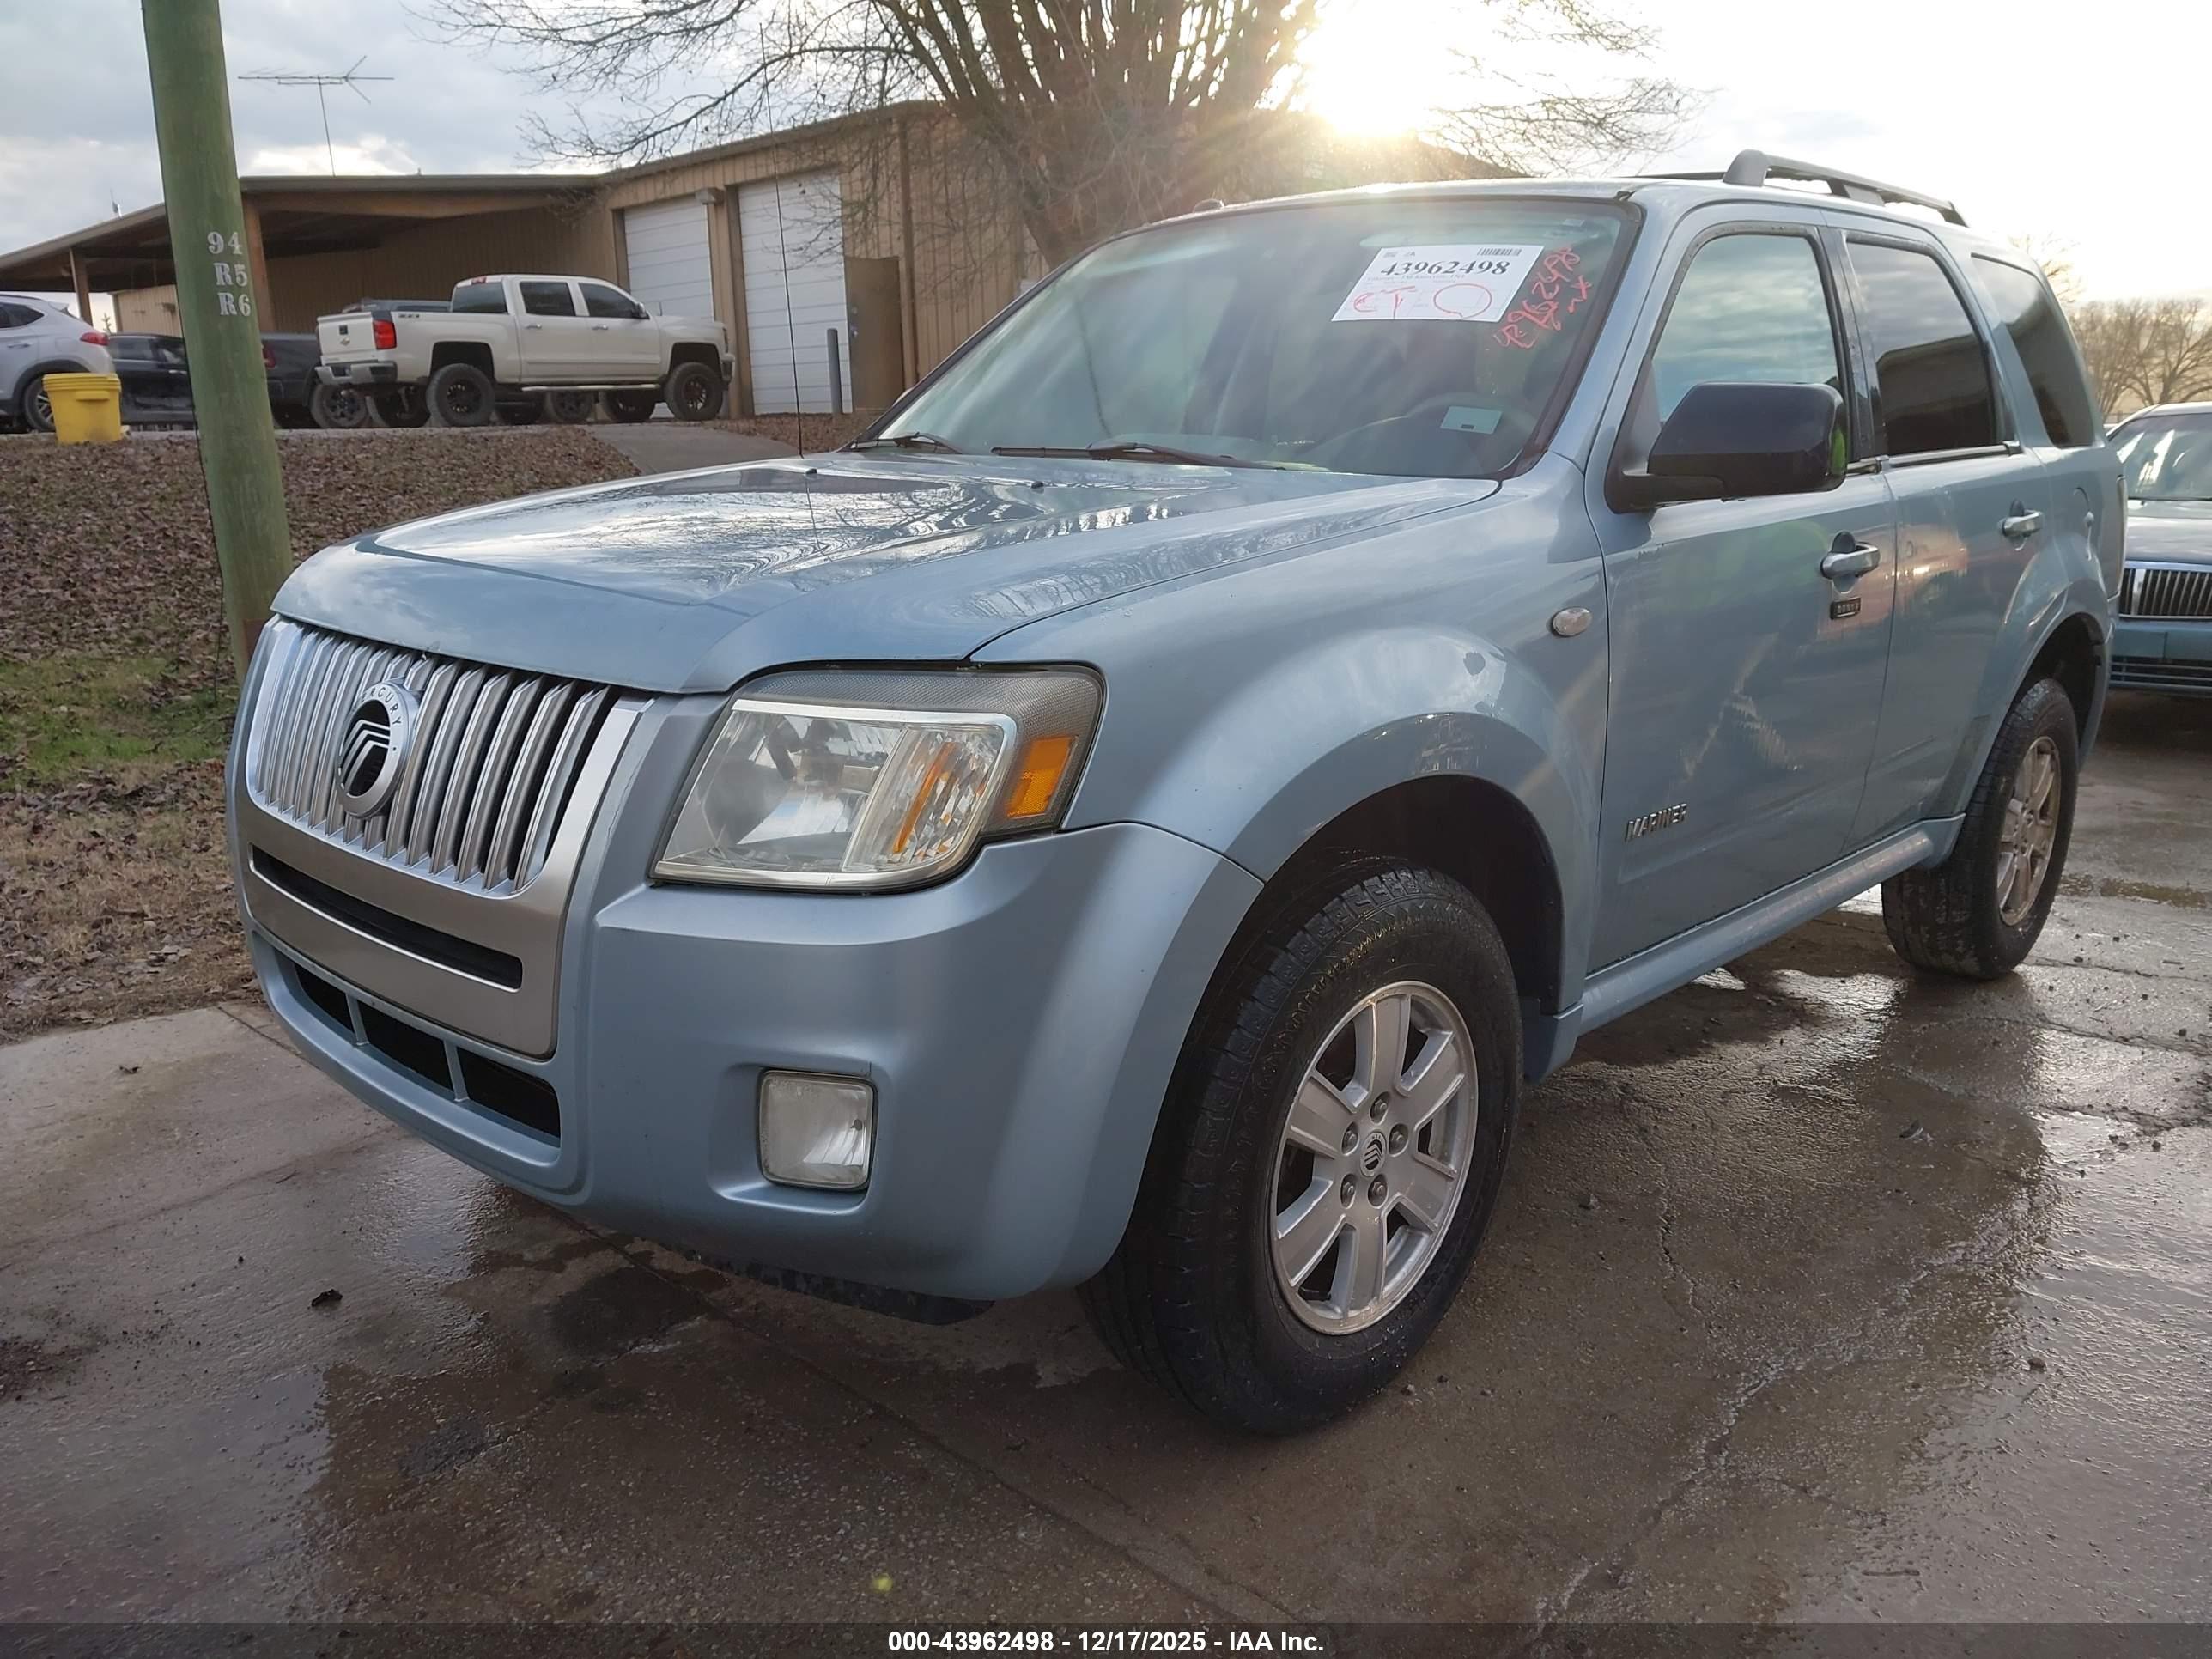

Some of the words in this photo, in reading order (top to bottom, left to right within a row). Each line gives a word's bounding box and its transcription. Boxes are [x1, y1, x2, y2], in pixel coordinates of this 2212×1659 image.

[207, 231, 243, 255] 94
[213, 263, 248, 287] R5
[1381, 260, 1510, 276] 43962498
[217, 292, 251, 317] R6
[353, 686, 402, 725] ERCURY
